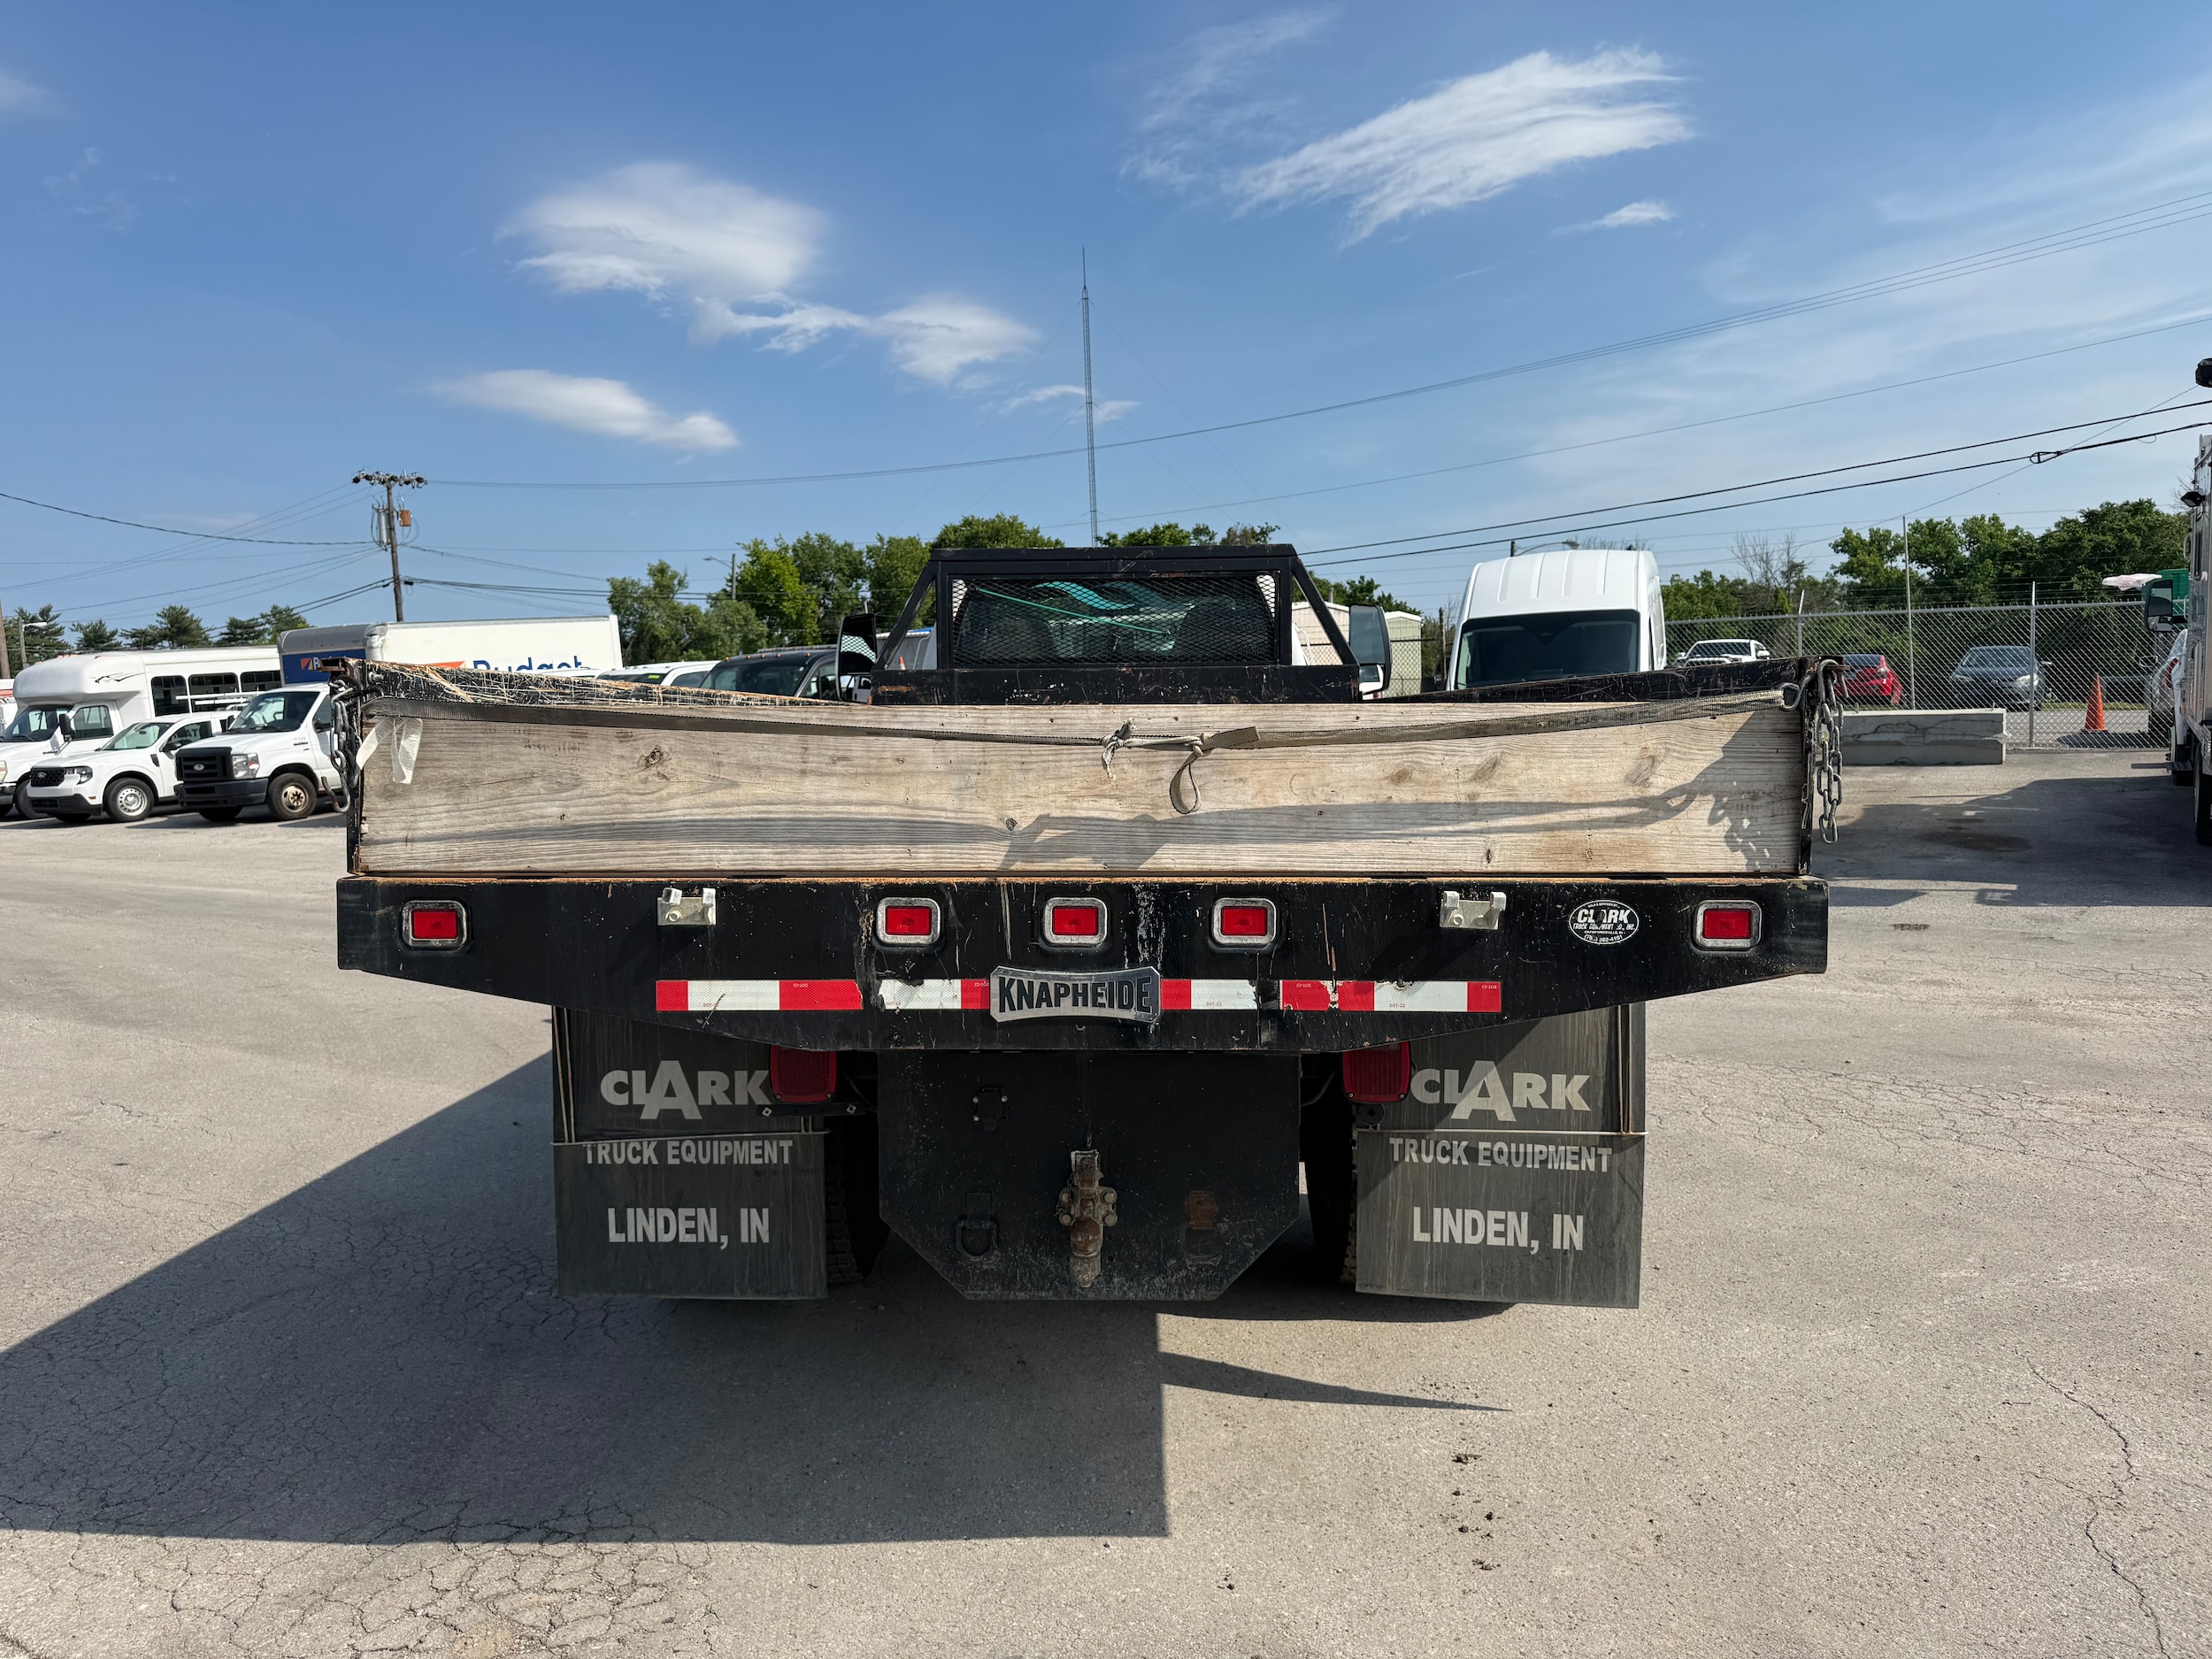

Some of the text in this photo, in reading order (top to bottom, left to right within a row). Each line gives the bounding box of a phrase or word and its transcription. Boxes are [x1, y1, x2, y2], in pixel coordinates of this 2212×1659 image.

[998, 975, 1152, 1014] KNAPHEIDE
[600, 1060, 772, 1120] CLARK
[1409, 1060, 1592, 1122] CLARK
[583, 1140, 794, 1165] TRUCK EQUIPMENT
[1389, 1137, 1612, 1172] TRUCK EQUIPMENT
[607, 1208, 770, 1250] LINDEN, IN
[1413, 1206, 1584, 1255] LINDEN, IN
